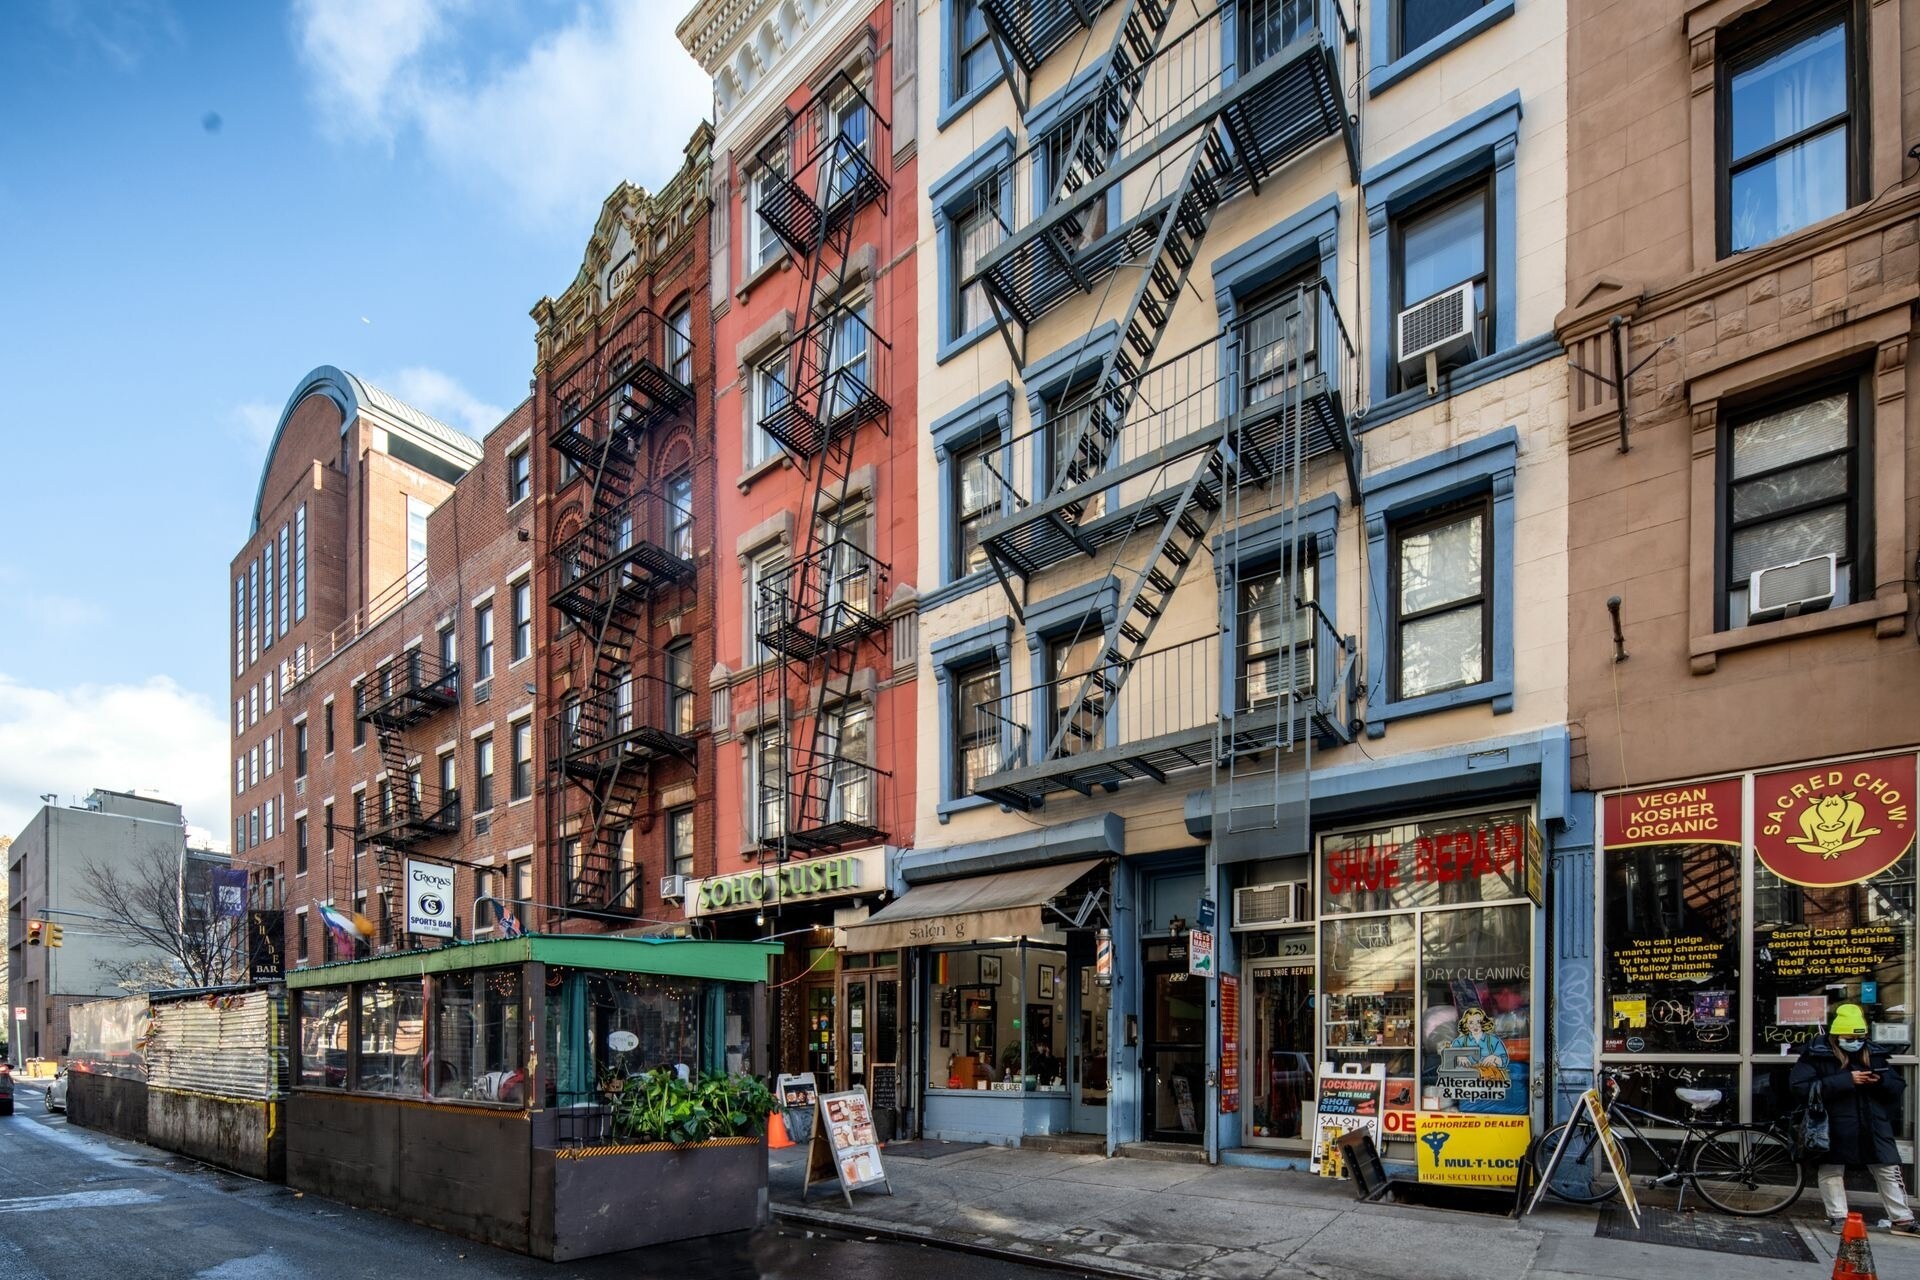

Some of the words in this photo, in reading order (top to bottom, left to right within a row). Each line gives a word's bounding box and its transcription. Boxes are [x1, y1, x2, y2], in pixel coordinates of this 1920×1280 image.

[1637, 788, 1706, 808] VEGAN
[1763, 771, 1843, 836] SACRED
[1853, 772, 1908, 821] CHOW
[1631, 802, 1714, 824] KOSHER
[1626, 818, 1718, 839] ORGANIC
[1327, 844, 1400, 896] SHOE
[1415, 824, 1523, 886] REPAIR
[699, 872, 767, 909] SOHO
[776, 856, 861, 896] SUSHI
[410, 916, 438, 927] SPORTS
[438, 920, 452, 928] BAR
[254, 912, 280, 964] SHADE
[1772, 930, 1811, 939] Sacred
[1814, 928, 1847, 937] Chow
[1850, 926, 1891, 935] serves
[1632, 940, 1652, 948] You
[1653, 938, 1672, 946] can
[1674, 936, 1703, 946] judge
[1768, 939, 1810, 949] serious
[1812, 938, 1848, 948] vegan
[1851, 935, 1895, 944] cuisine
[1285, 943, 1307, 956] 229
[1622, 948, 1651, 956] man's
[1653, 946, 1673, 954] true
[1675, 943, 1724, 953] character
[1789, 947, 1832, 957] without
[1834, 946, 1872, 955] taking
[1619, 958, 1631, 966] by
[1651, 956, 1671, 964] way
[1688, 952, 1718, 960] treats
[1829, 954, 1884, 965] seriously
[256, 965, 278, 973] BAR
[1273, 968, 1289, 977] SHOE
[1291, 967, 1314, 976] REPAIR
[1425, 968, 1453, 981] DRY
[1457, 965, 1530, 981] CLEANING
[1623, 965, 1638, 974] his
[1640, 964, 1669, 972] fellow
[1632, 972, 1653, 981] Paul
[1656, 970, 1708, 980] McCartney
[1778, 967, 1802, 976] New
[1322, 1080, 1377, 1090] LOCKSMITH
[1437, 1077, 1511, 1090] Alterations
[1442, 1089, 1452, 1098] &
[1454, 1089, 1505, 1102] Repairs
[1320, 1105, 1355, 1113] REPAIR
[1321, 1116, 1360, 1128] SALON
[1384, 1112, 1416, 1133] OE
